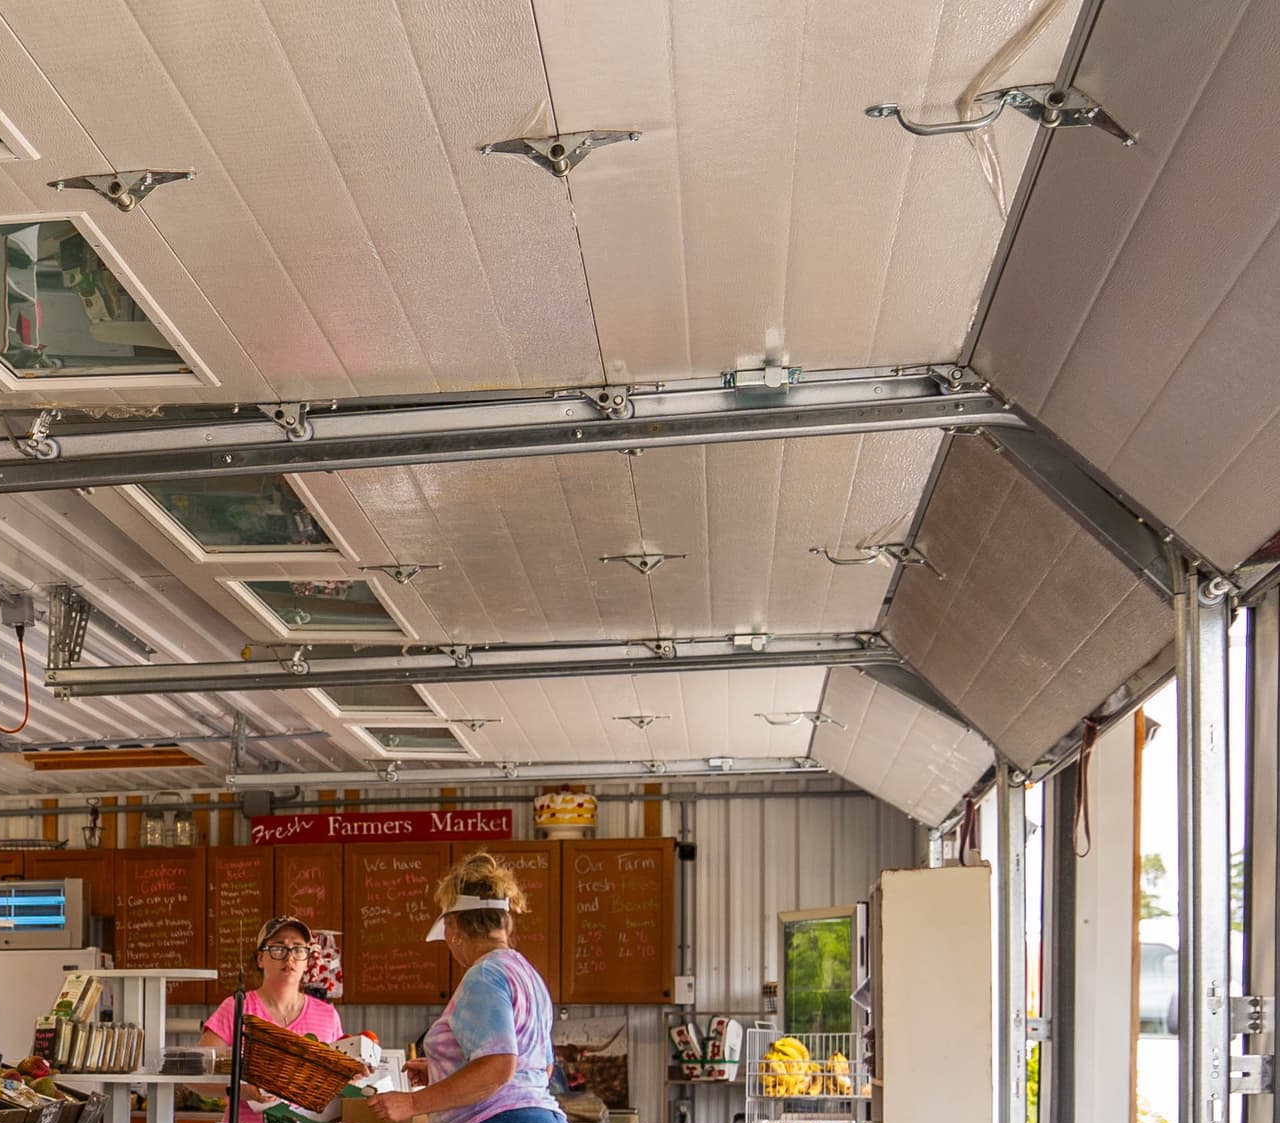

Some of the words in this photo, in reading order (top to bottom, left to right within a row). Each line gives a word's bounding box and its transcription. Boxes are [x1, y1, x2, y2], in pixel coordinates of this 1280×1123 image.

[251, 816, 315, 843] Fresh
[327, 815, 413, 836] Farmers
[430, 811, 510, 833] Market
[363, 857, 388, 873] We
[392, 857, 422, 871] have
[575, 855, 605, 875] Our
[617, 851, 656, 872] Farm
[128, 895, 144, 907] Can
[146, 896, 161, 904] run
[178, 893, 188, 902] to
[576, 897, 600, 914] and
